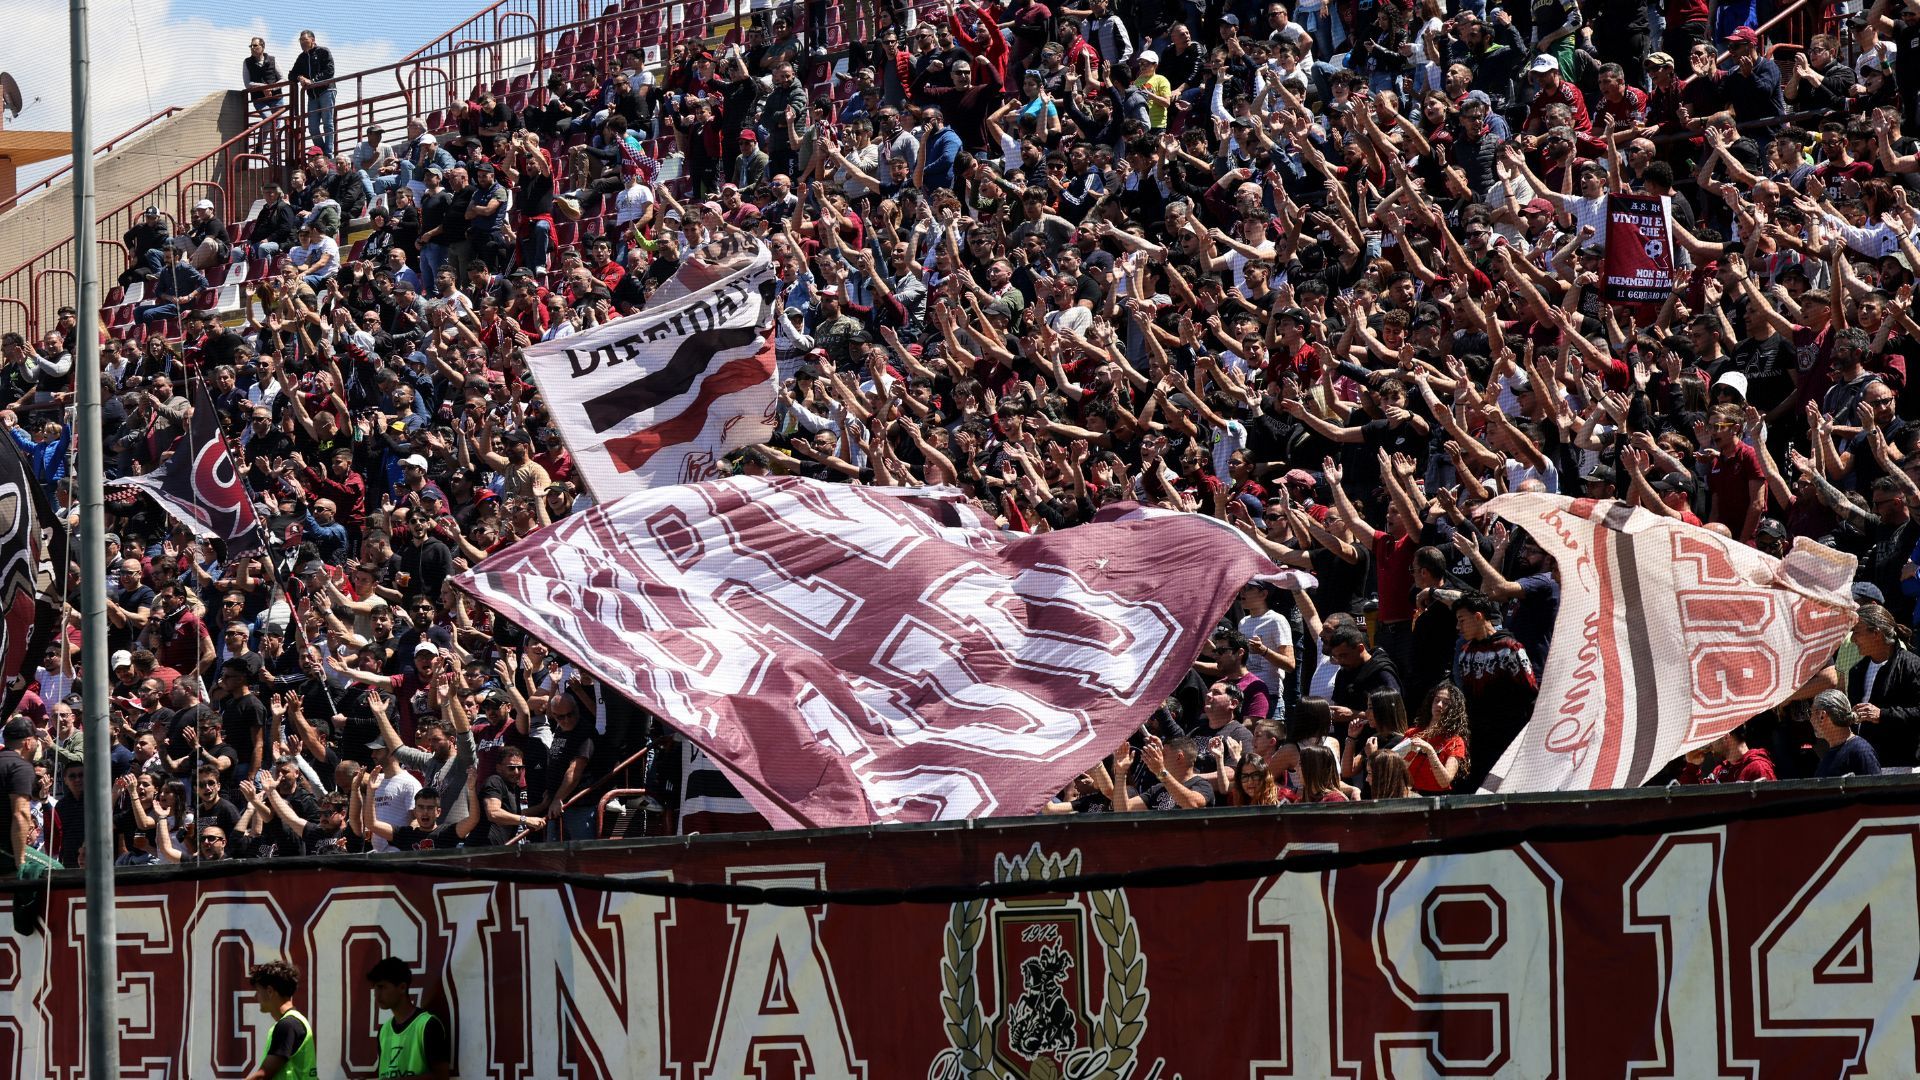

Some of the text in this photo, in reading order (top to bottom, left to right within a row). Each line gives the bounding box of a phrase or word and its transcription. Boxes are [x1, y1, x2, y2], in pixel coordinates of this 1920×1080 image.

[1612, 213, 1639, 225] VIVO
[1642, 216, 1653, 226] DI
[1639, 226, 1660, 237] CHE
[1636, 269, 1654, 279] NON
[1608, 276, 1654, 287] NEMMENO
[1021, 923, 1059, 942] 1914
[1247, 816, 1920, 1080] 1914
